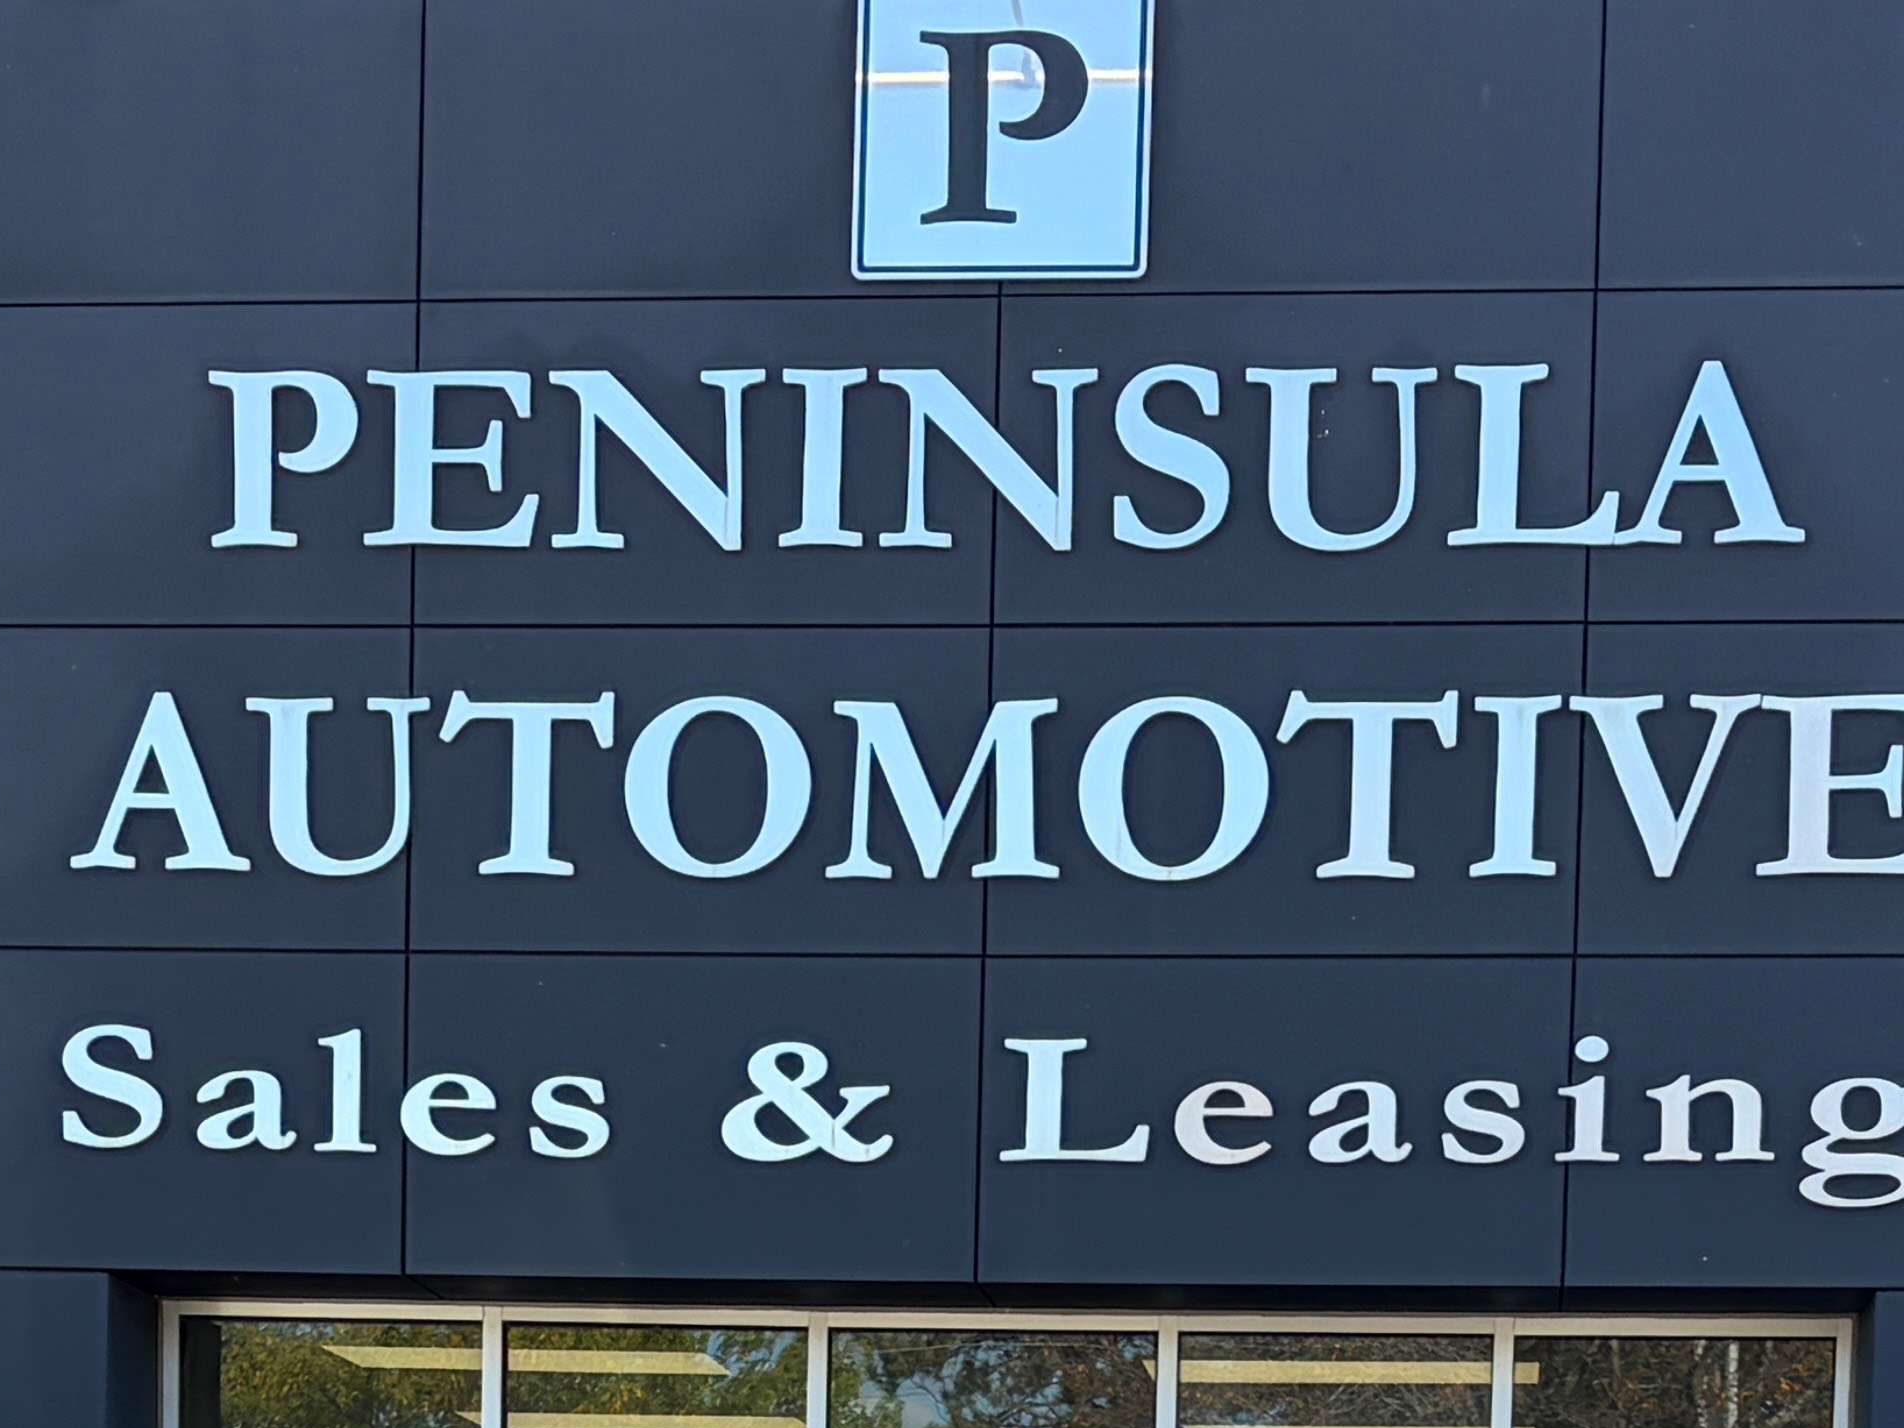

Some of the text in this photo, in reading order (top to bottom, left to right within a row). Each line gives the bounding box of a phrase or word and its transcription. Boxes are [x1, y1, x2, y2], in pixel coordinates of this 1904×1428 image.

[919, 30, 1089, 225] P
[207, 359, 1807, 553] PENINSULA
[60, 1022, 611, 1160] Sales
[720, 1040, 894, 1164] &
